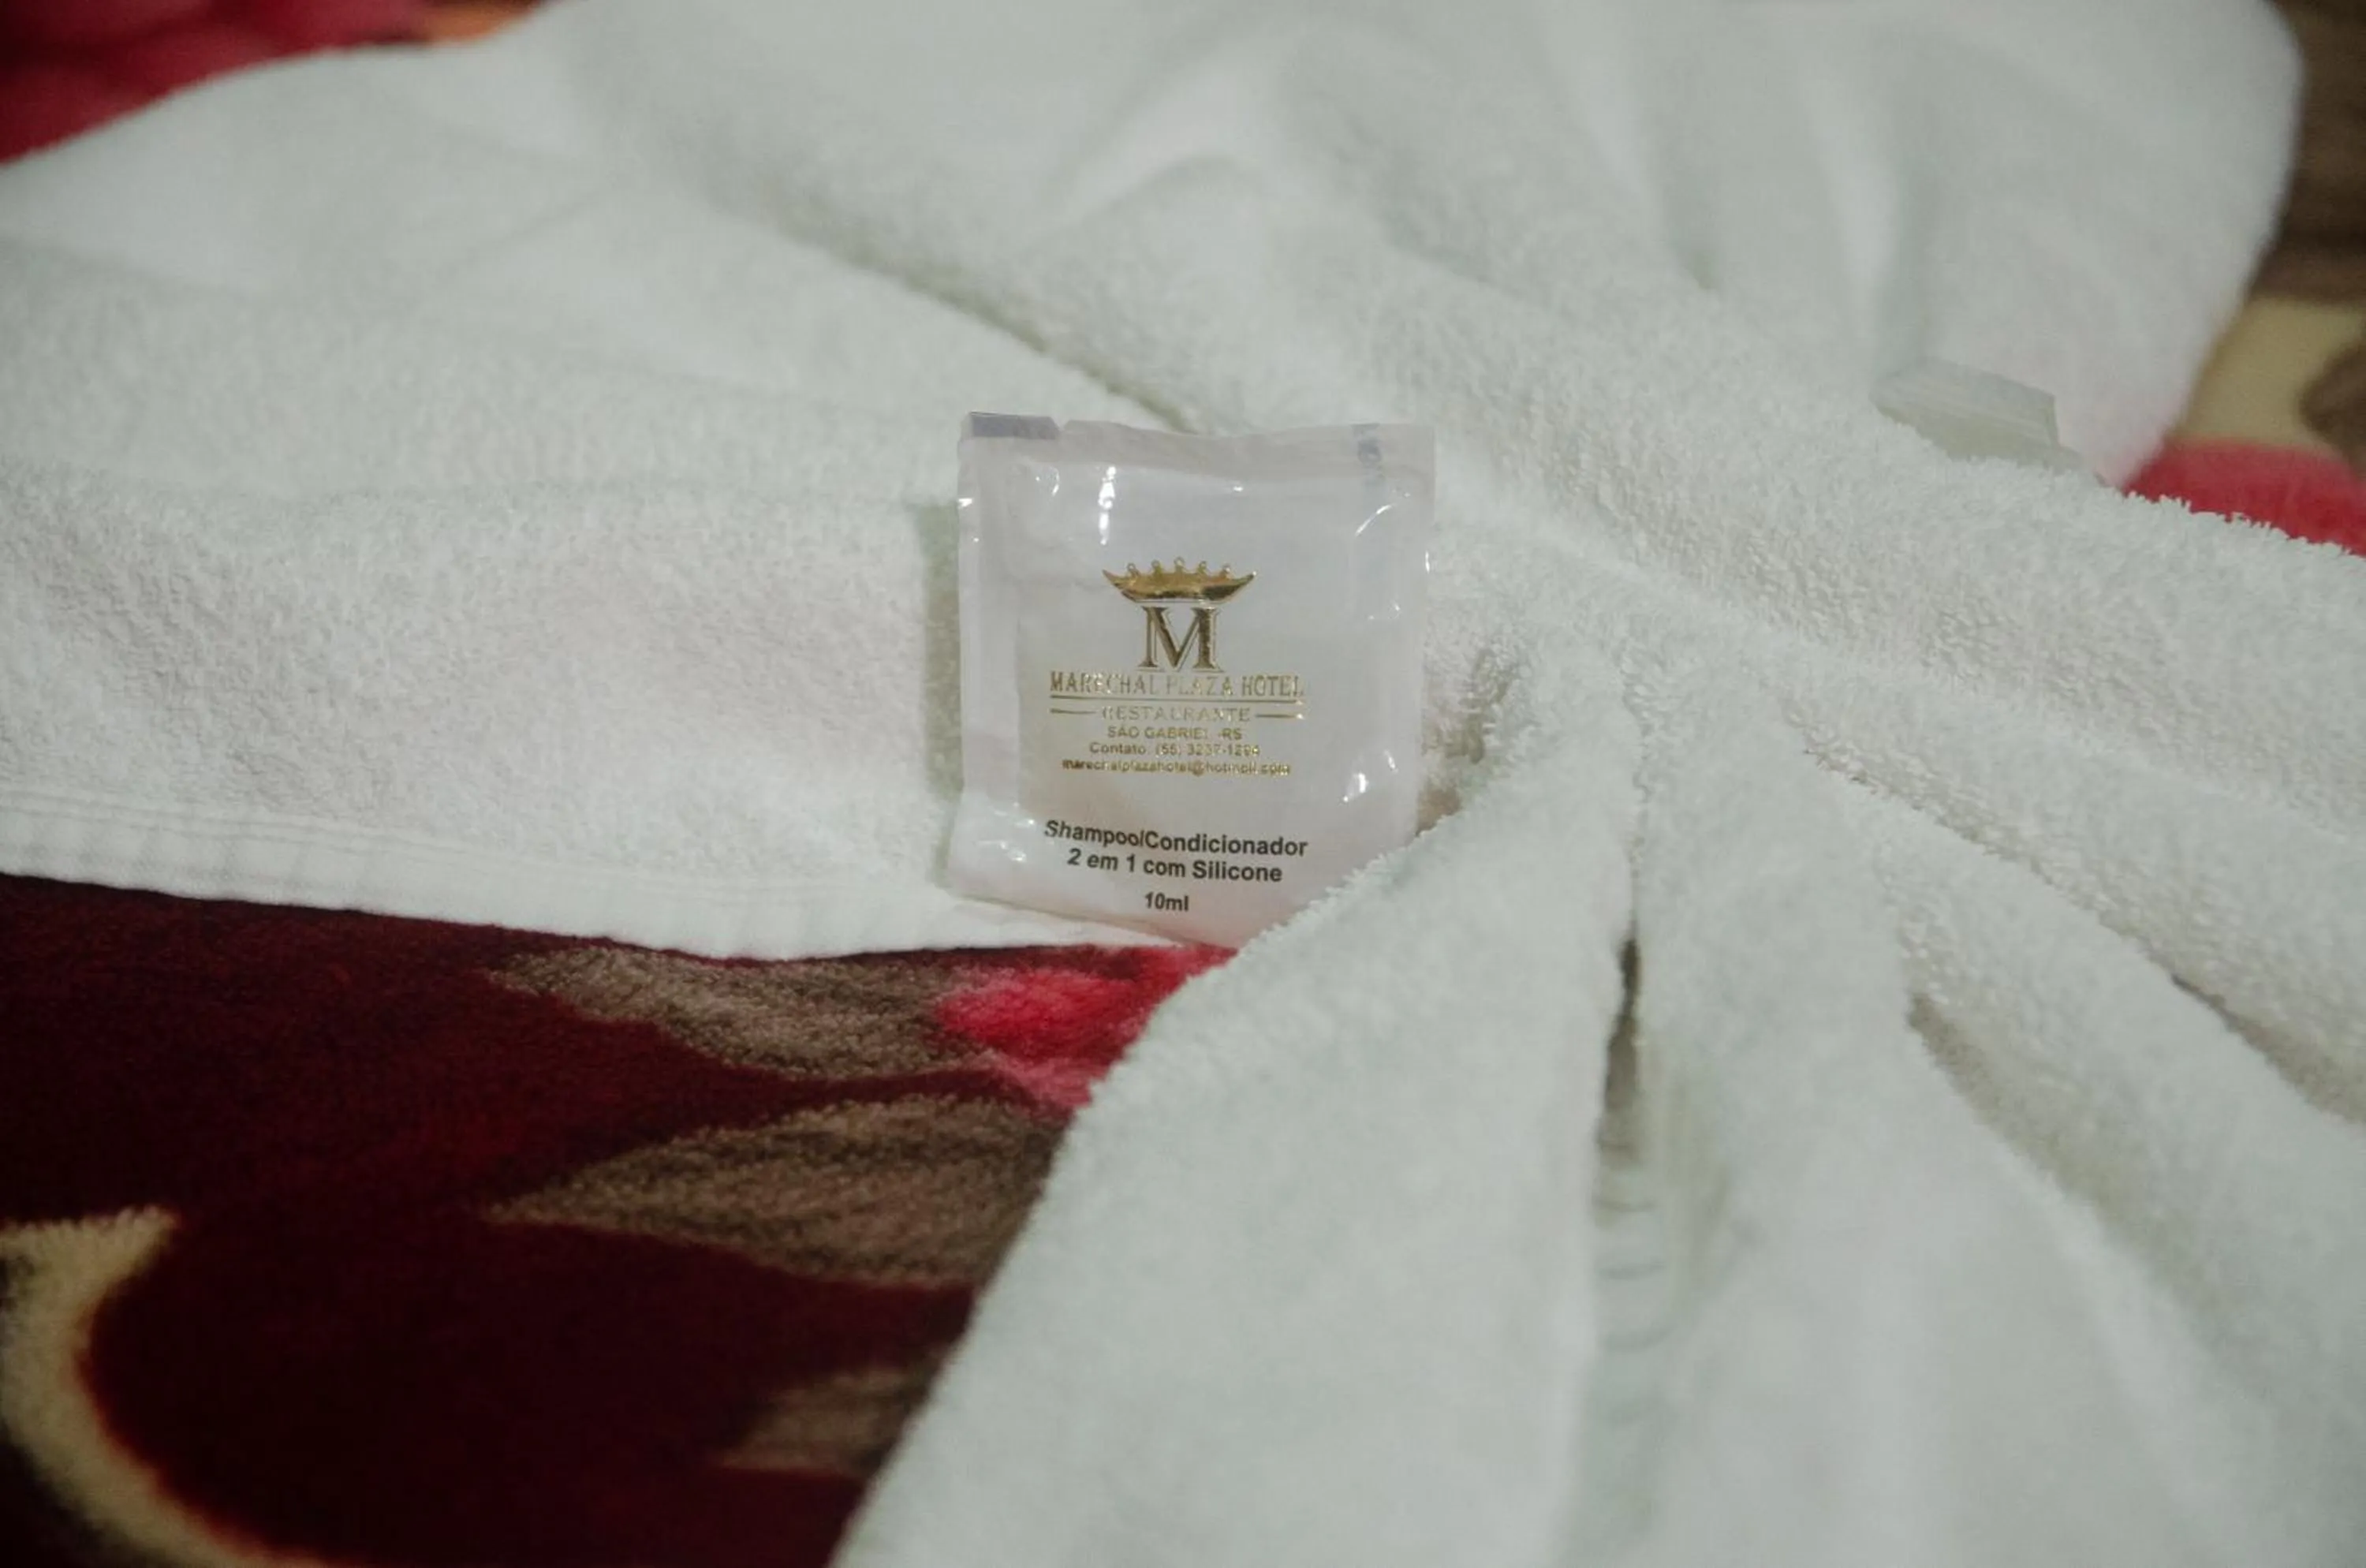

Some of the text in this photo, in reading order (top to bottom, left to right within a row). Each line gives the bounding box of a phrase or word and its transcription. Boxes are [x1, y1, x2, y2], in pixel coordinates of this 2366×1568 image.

[1137, 605, 1224, 673] M
[1050, 671, 1304, 697] MARECHAL PLAZA HOTEL
[1102, 705, 1251, 722] RESTAURANTE
[1107, 725, 1140, 739] SÃO
[1144, 726, 1208, 741] GABRIEL
[1066, 848, 1284, 883] 2 em 1 com Silicone
[1144, 891, 1190, 913] 10ml
